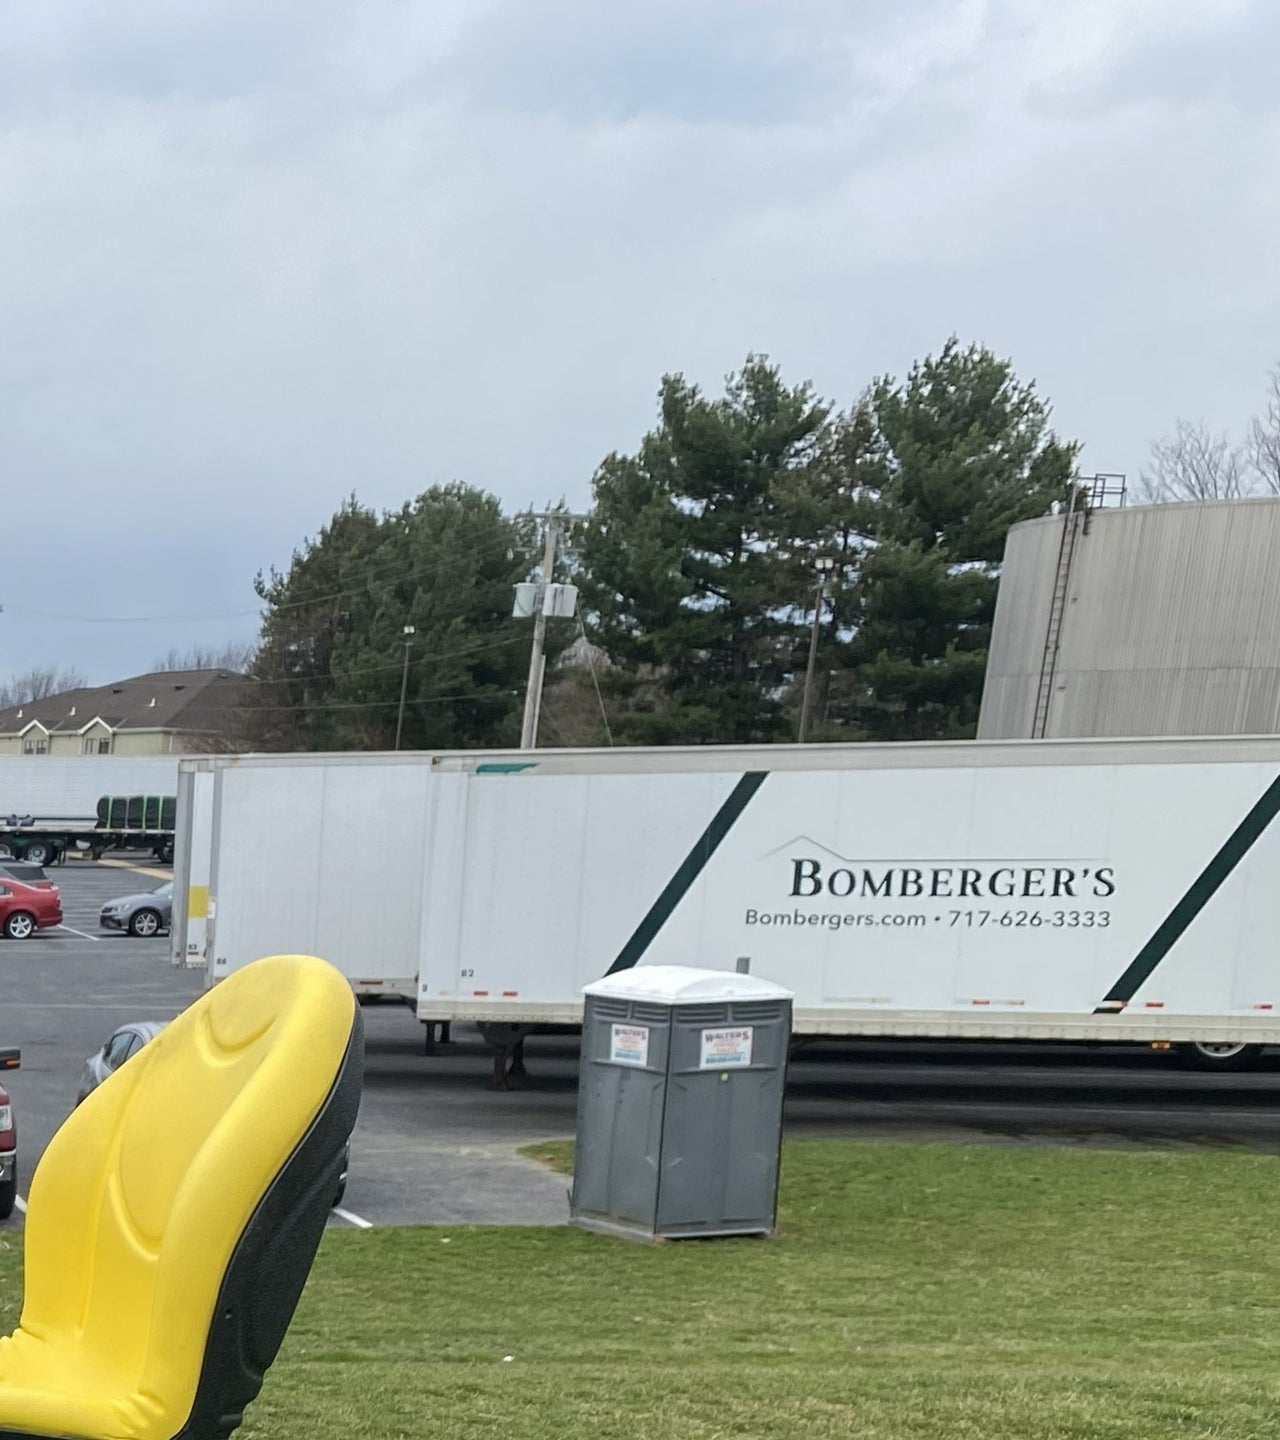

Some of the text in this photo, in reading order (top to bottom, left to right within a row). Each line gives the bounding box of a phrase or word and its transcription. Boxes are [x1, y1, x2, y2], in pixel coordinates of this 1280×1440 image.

[790, 859, 1115, 898] BOMBERGER'S
[746, 908, 1111, 931] Bombergers.com 717-626-3333
